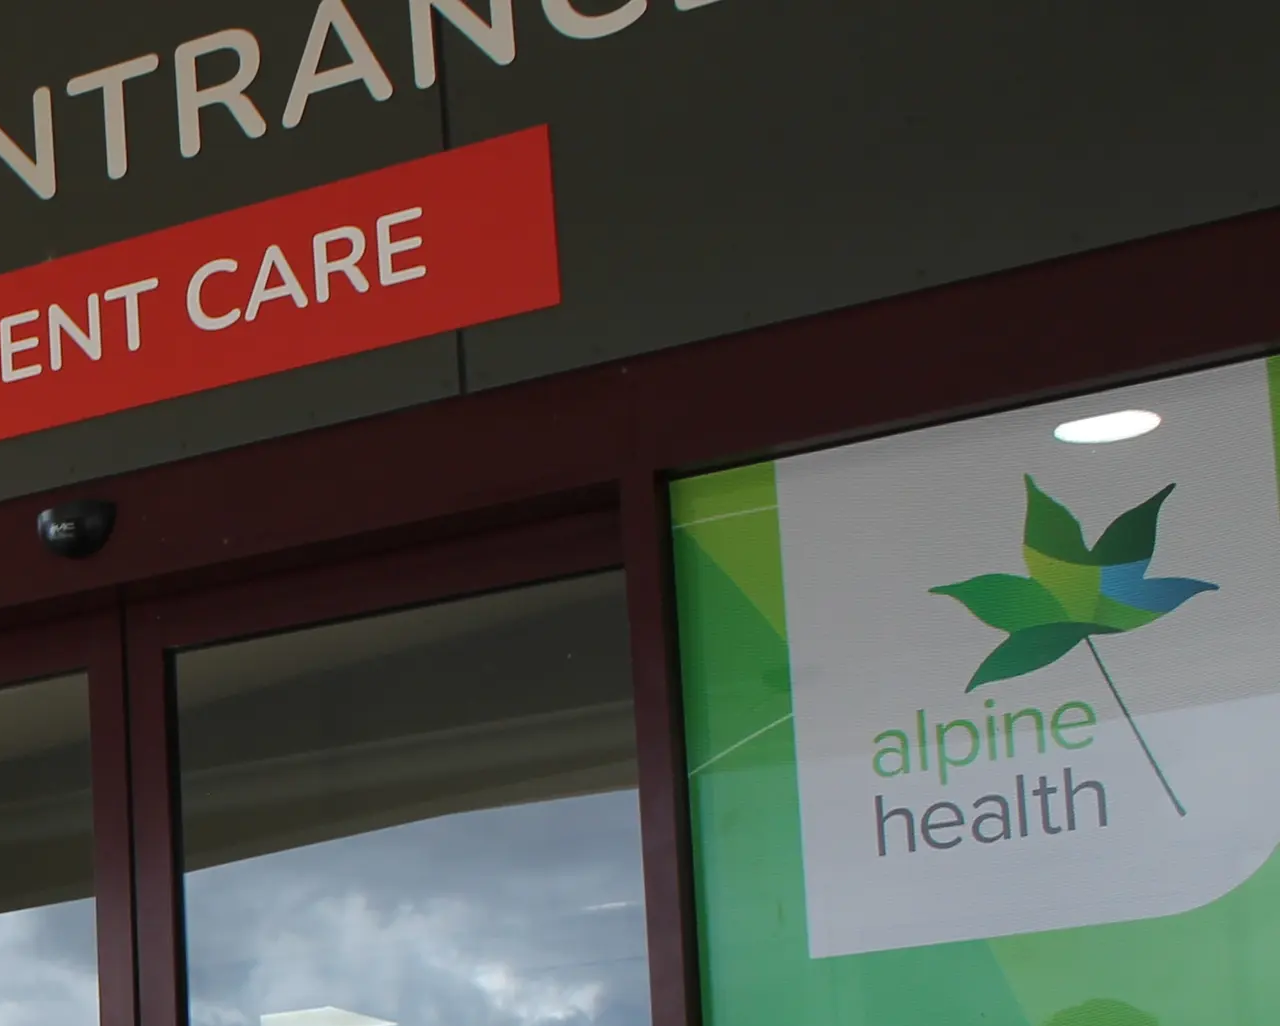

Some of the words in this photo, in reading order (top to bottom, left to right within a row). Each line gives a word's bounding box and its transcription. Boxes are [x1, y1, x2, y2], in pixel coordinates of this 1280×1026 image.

[186, 206, 427, 330] CARE
[871, 698, 1098, 785] alpine
[874, 767, 1108, 857] health
